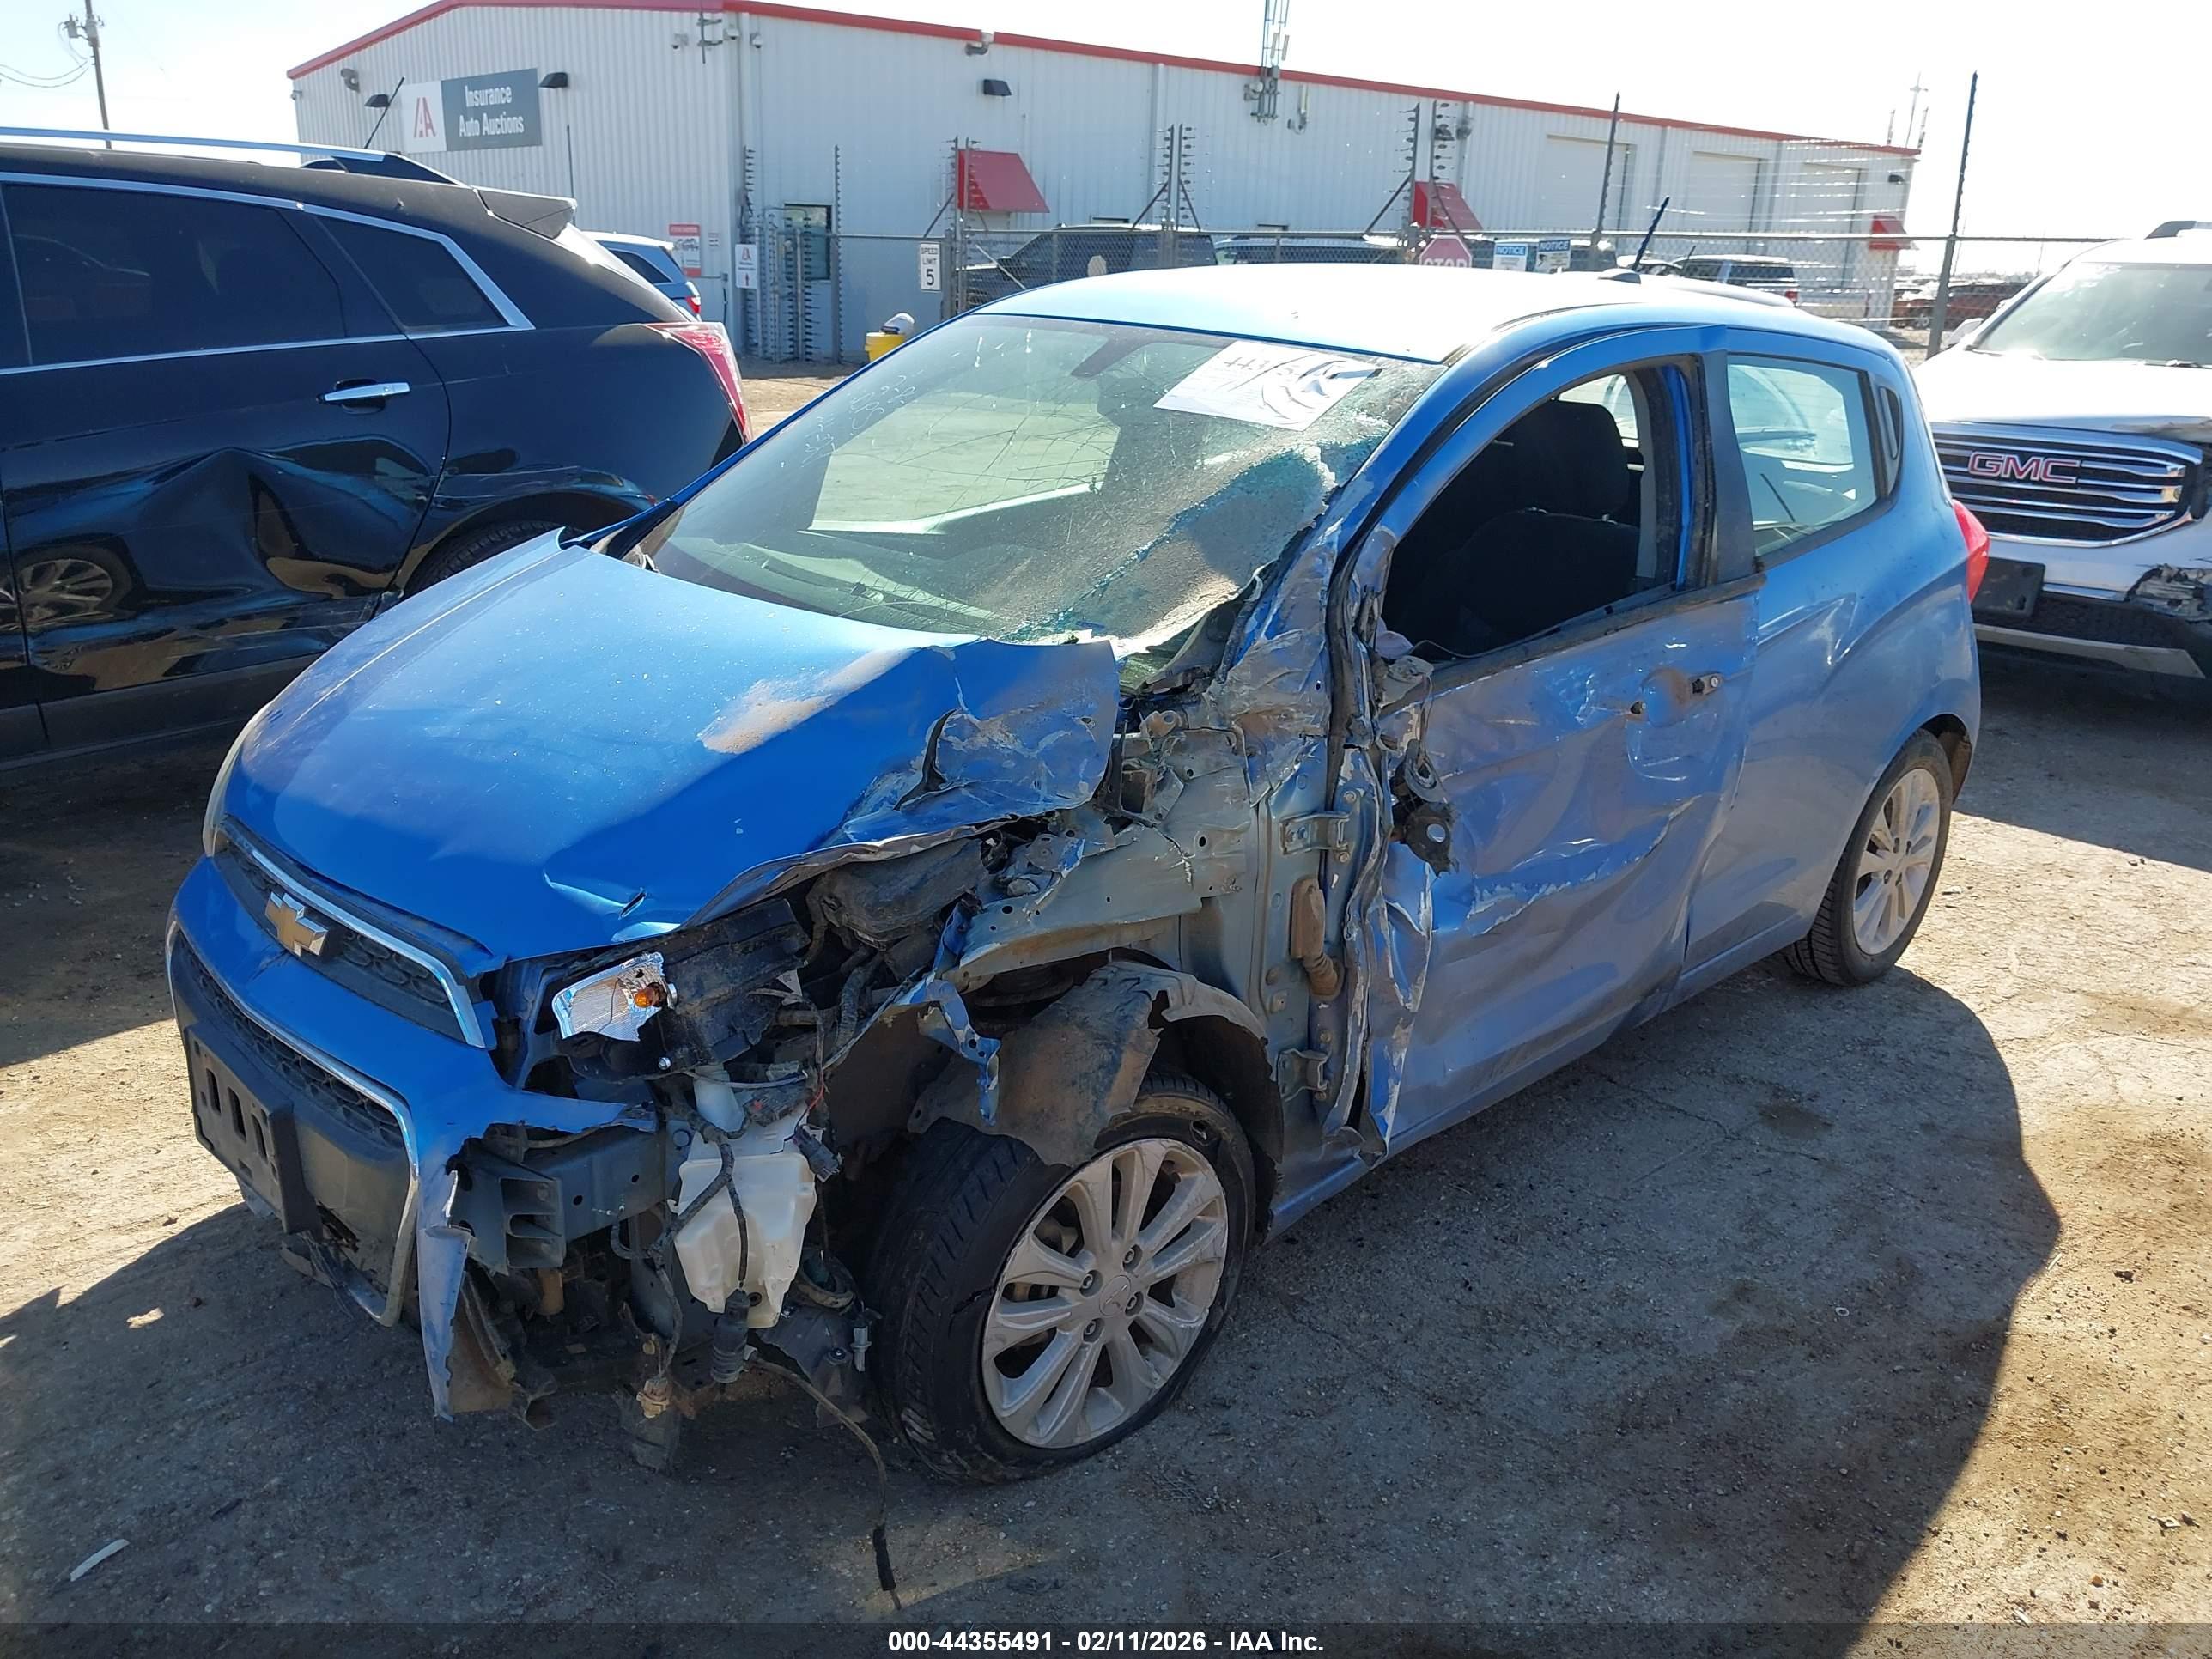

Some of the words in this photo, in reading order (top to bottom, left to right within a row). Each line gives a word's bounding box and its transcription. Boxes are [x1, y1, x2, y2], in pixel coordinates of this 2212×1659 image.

[465, 85, 513, 107] Insurance
[459, 114, 480, 137] Auto
[482, 111, 525, 136] Auctions
[1497, 246, 1524, 255] NOTICE
[1540, 241, 1569, 251] NOTICE
[926, 268, 935, 286] 5
[1967, 451, 2081, 484] GMC
